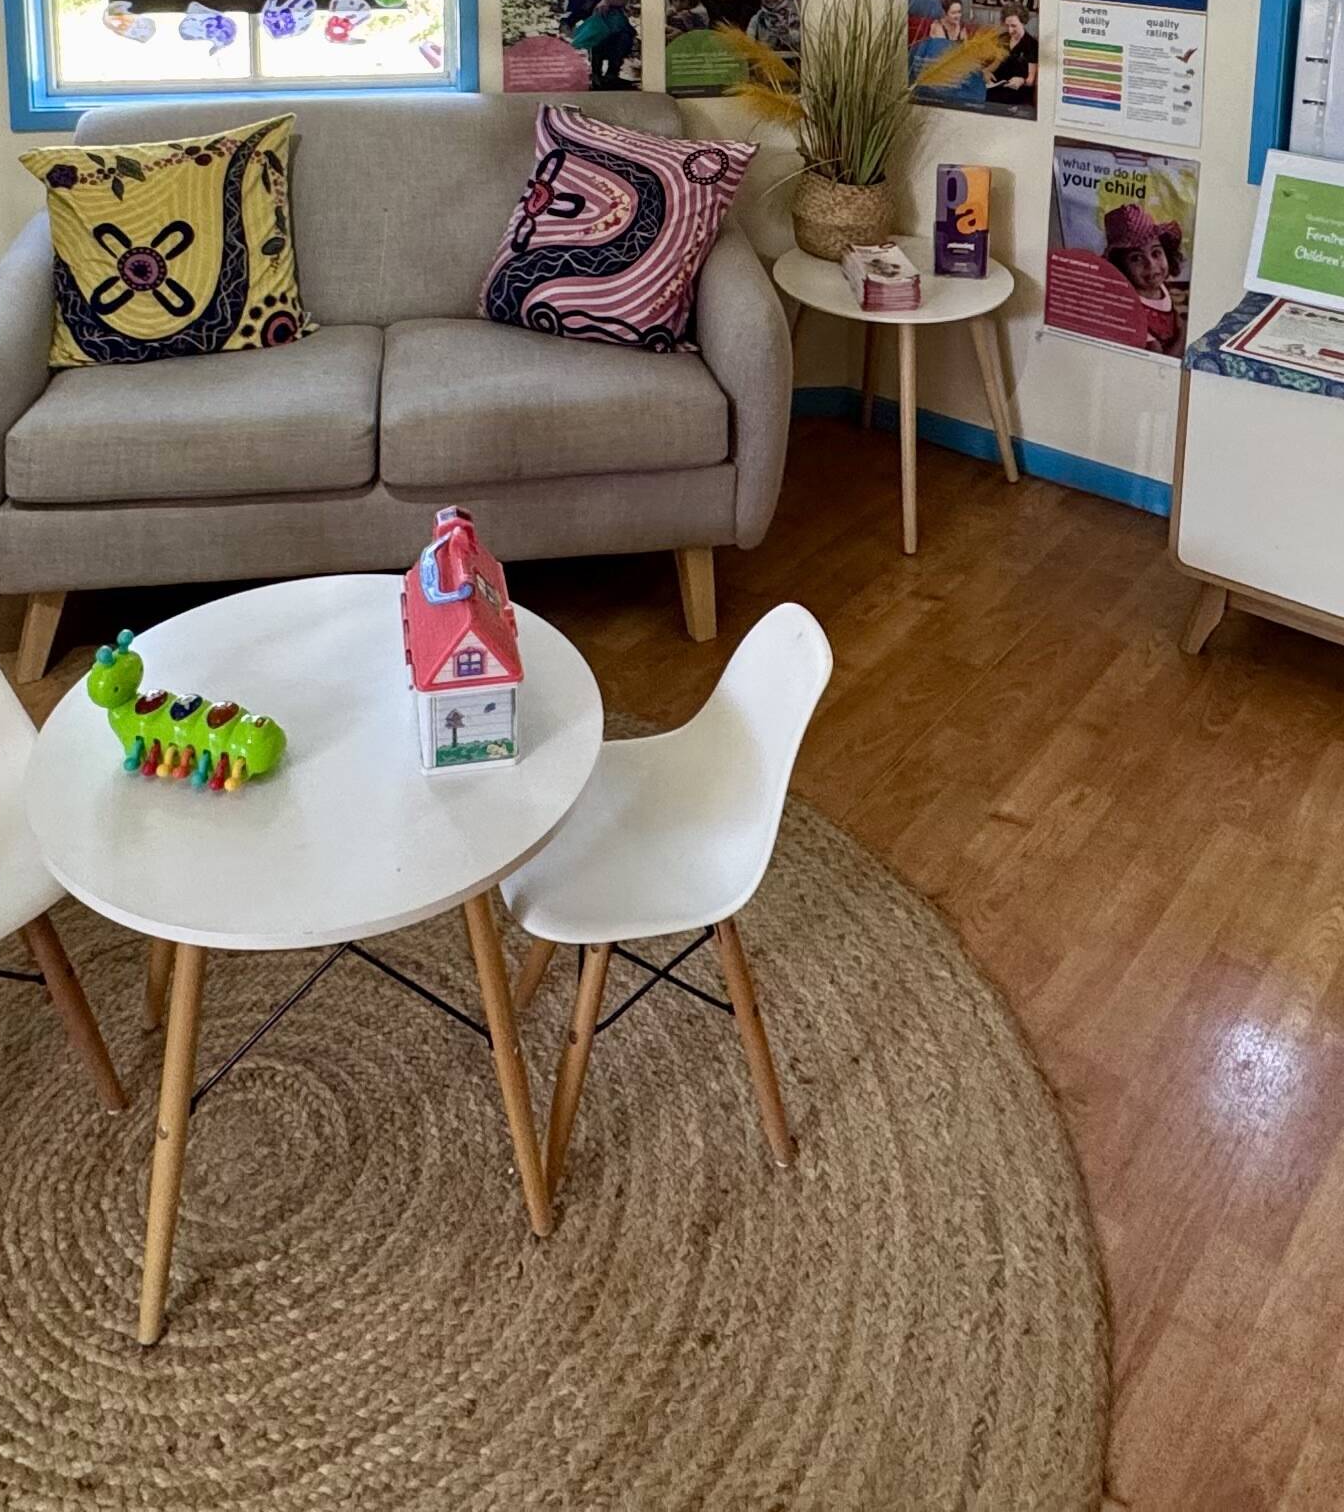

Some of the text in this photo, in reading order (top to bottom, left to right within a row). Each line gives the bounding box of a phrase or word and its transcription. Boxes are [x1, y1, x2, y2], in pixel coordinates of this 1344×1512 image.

[1081, 8, 1108, 16] seven
[1078, 16, 1110, 29] quality
[1146, 18, 1180, 30] quality
[1081, 26, 1106, 37] areas
[1146, 29, 1179, 41] ratings
[1063, 157, 1148, 183] what we do for
[1062, 172, 1146, 199] your child
